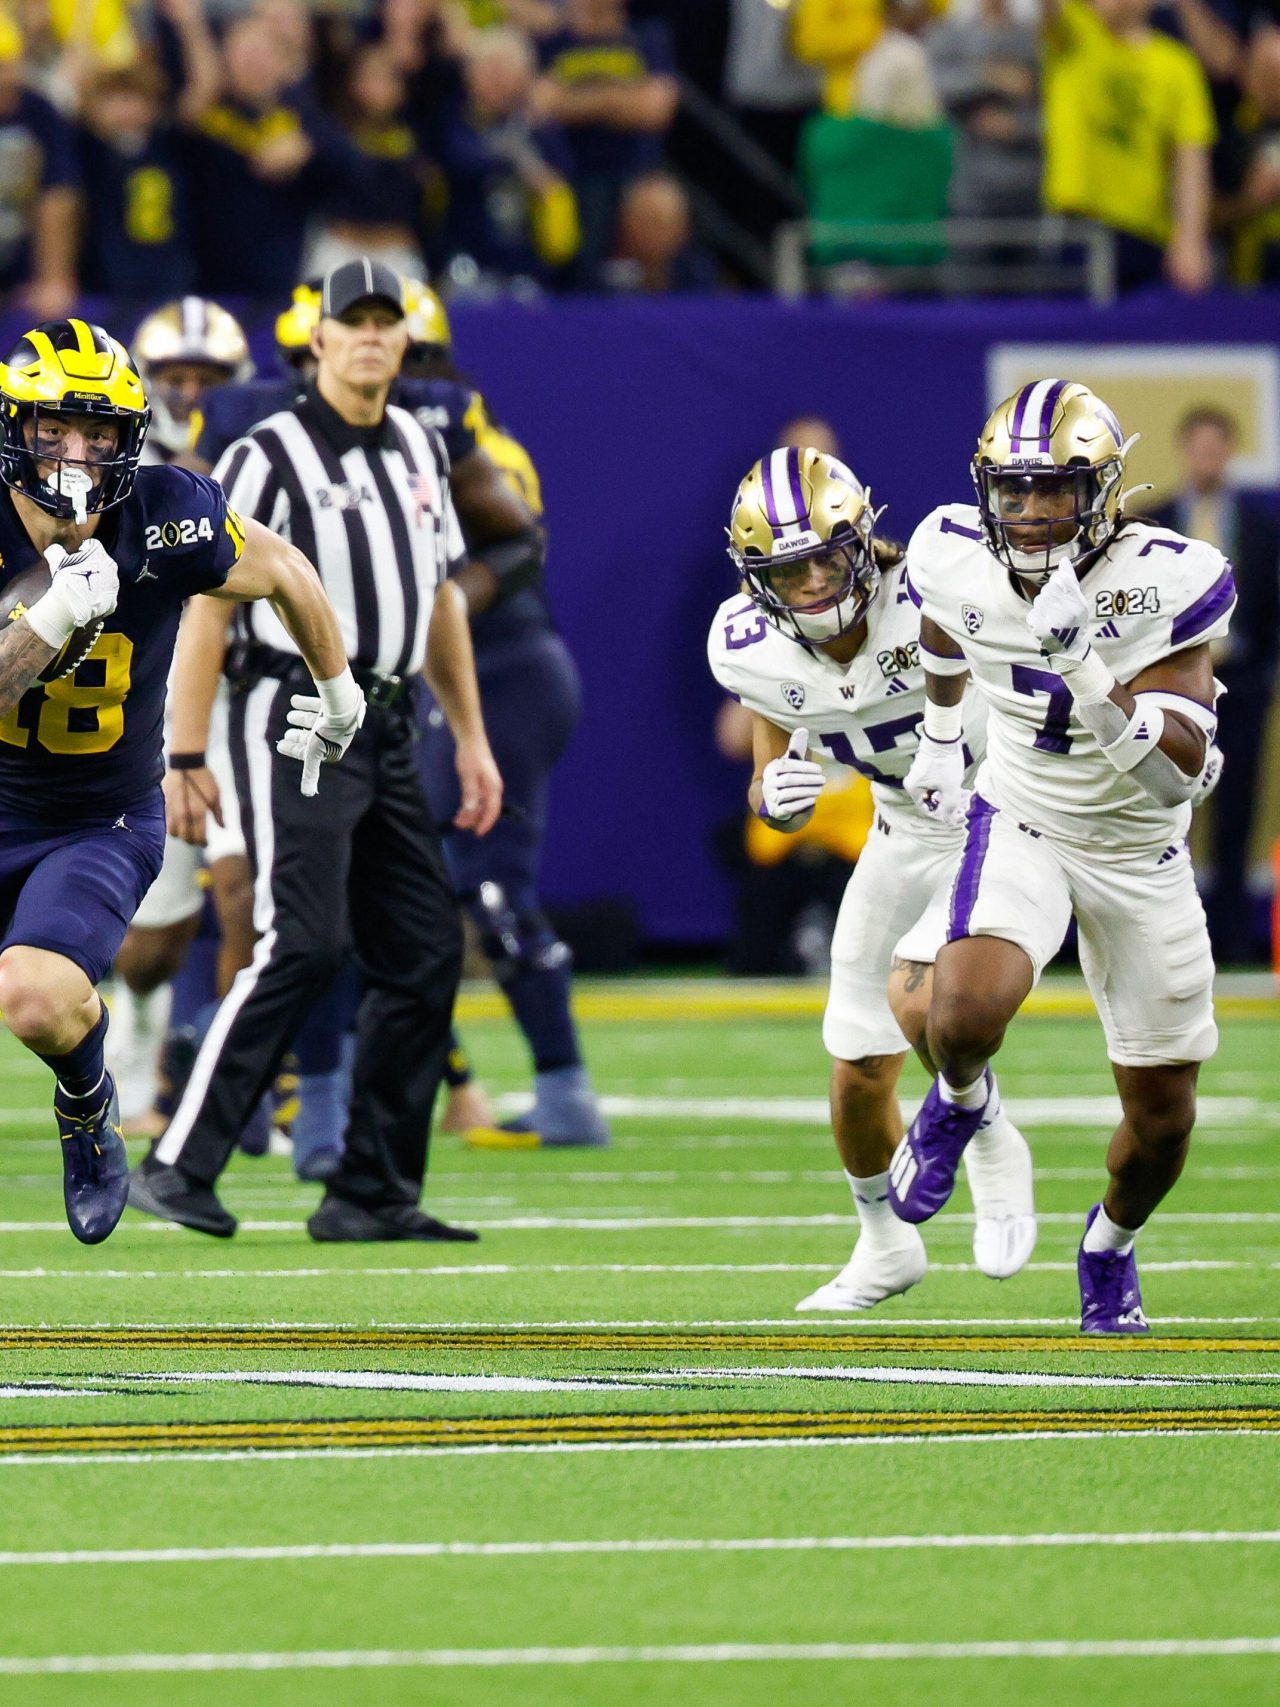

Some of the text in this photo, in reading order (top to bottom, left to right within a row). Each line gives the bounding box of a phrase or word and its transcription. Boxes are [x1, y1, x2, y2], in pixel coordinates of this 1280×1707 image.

[145, 517, 214, 550] 2024
[1096, 587, 1160, 618] 2024
[877, 640, 921, 678] 202
[839, 685, 856, 700] W
[1011, 664, 1074, 755] 7
